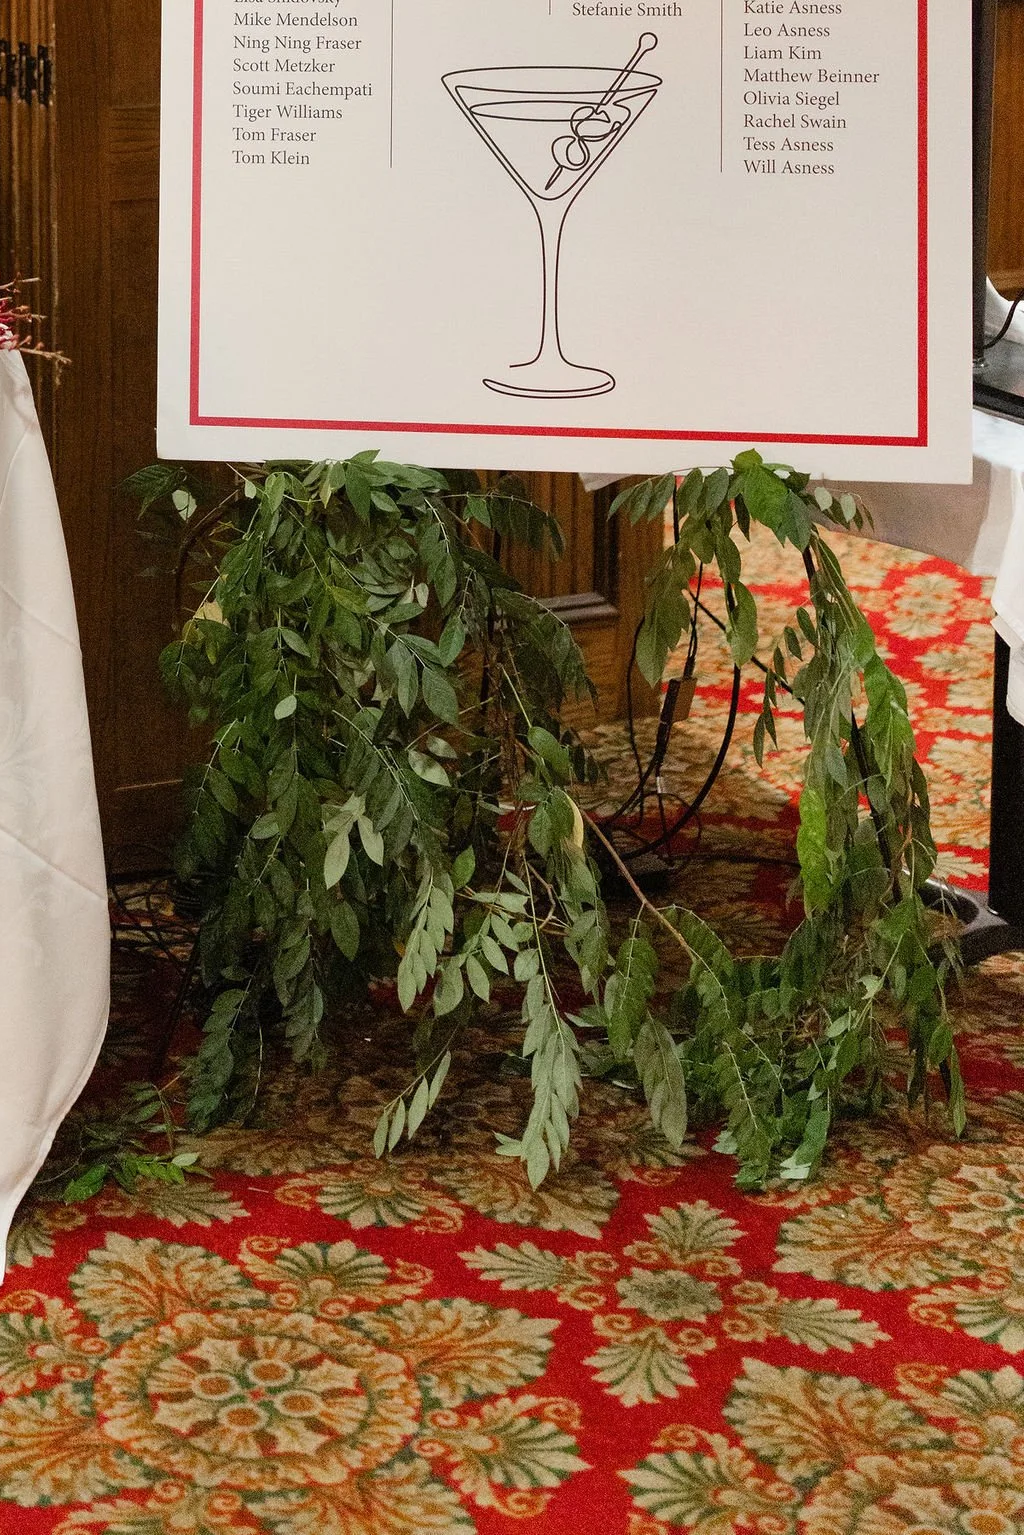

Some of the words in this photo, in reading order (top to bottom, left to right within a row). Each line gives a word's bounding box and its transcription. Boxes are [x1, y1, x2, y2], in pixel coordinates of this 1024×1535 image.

[572, 1, 633, 17] Stefanie
[636, 1, 683, 17] Smith
[743, 0, 784, 14] Katie
[788, 0, 843, 15] Asness
[233, 11, 272, 27] Mike
[275, 11, 359, 27] Mendelson
[743, 22, 773, 37] Leo
[776, 23, 831, 38] Asness
[233, 35, 271, 54] Ning
[274, 35, 312, 54] Ning
[315, 35, 363, 50] Fraser
[743, 45, 783, 60] Liam
[788, 45, 822, 60] Kim
[232, 57, 271, 73] Scott
[274, 57, 336, 73] Metzker
[743, 67, 813, 83] Matthew
[816, 68, 880, 84] Beinner
[232, 80, 281, 96] Soumi
[285, 81, 372, 101] Eachempati
[743, 90, 791, 106] Olivia
[795, 90, 840, 111] Siegel
[232, 103, 272, 123] Tiger
[275, 104, 343, 120] Williams
[743, 113, 796, 129] Rachel
[800, 113, 847, 129] Swain
[231, 127, 266, 141] Tom
[270, 127, 317, 142] Fraser
[742, 136, 776, 152] Tess
[780, 137, 834, 152] Asness
[231, 149, 265, 165] Tom
[271, 150, 310, 165] Klein
[743, 158, 776, 174] Will
[780, 159, 835, 175] Asness
